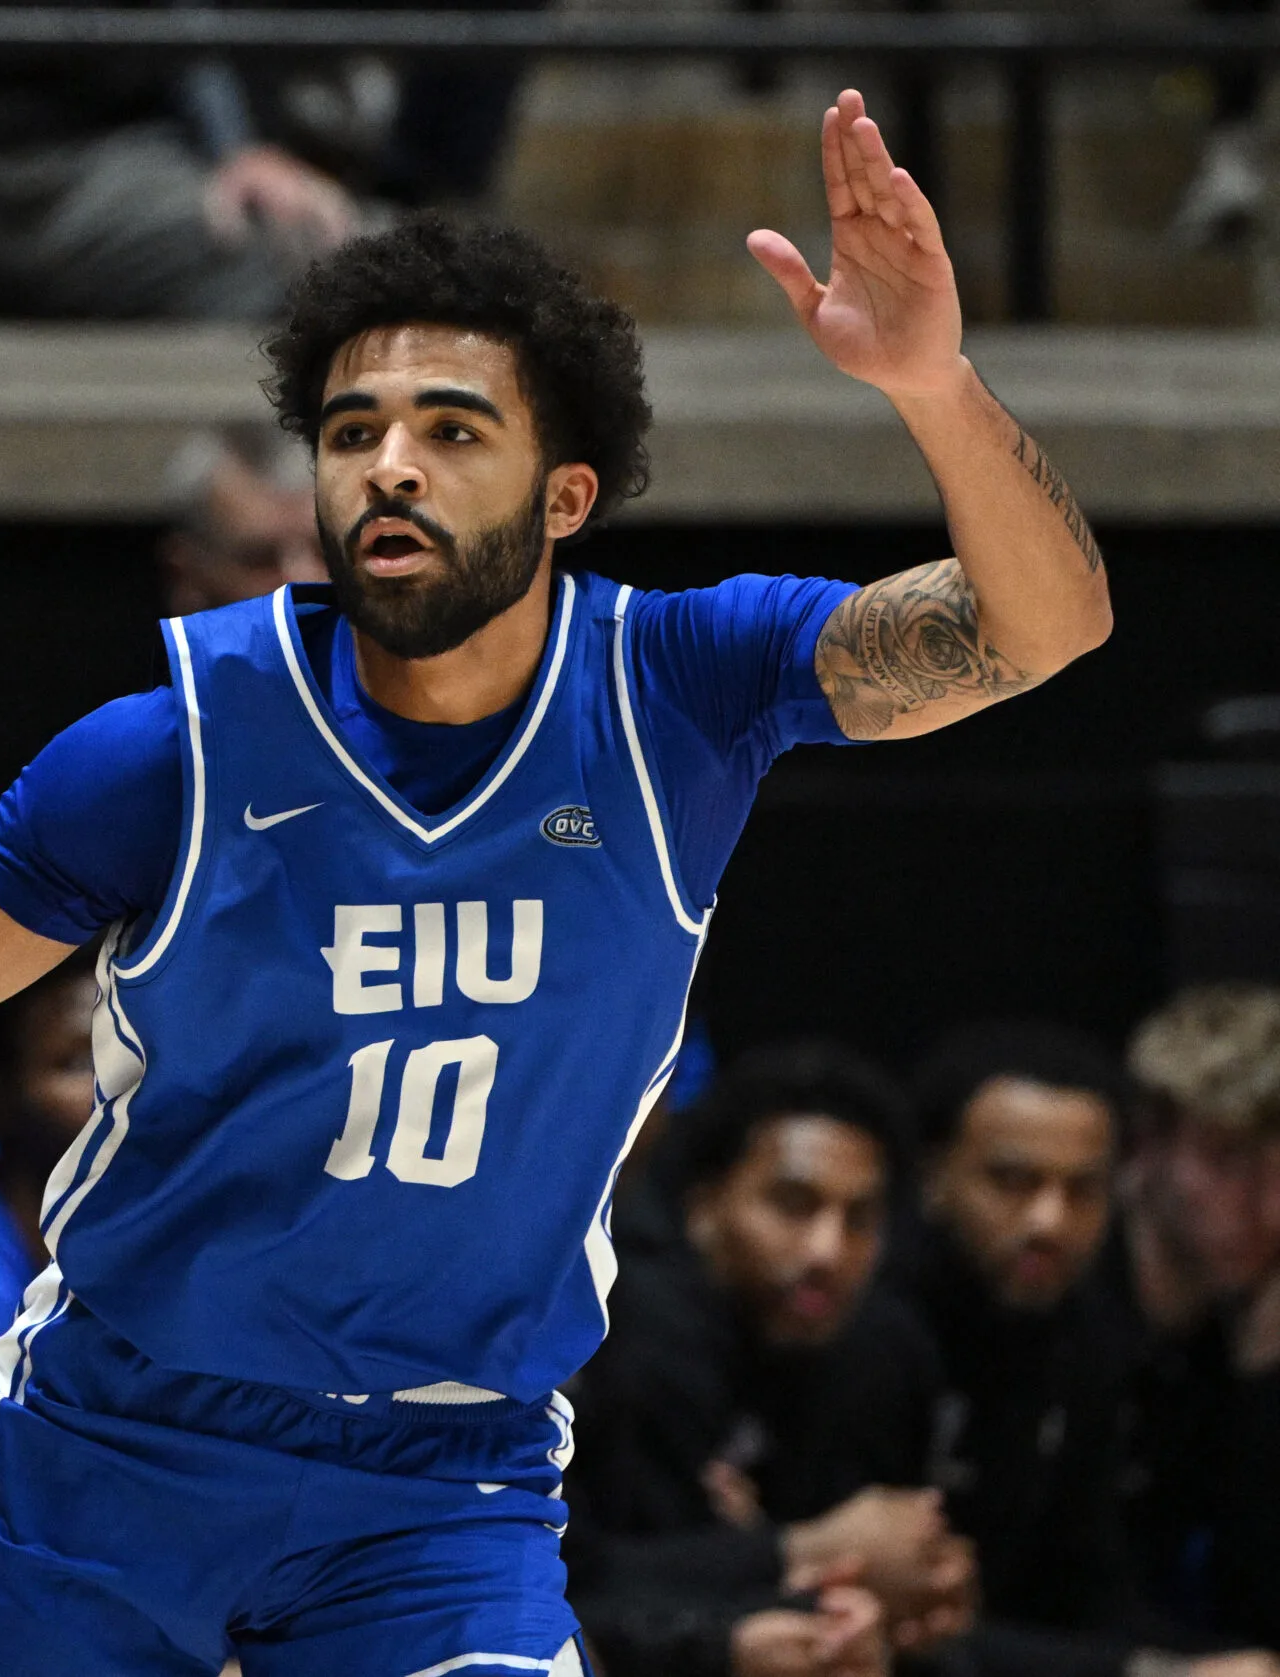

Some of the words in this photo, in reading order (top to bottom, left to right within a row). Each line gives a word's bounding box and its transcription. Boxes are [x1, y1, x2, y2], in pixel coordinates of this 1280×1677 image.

[555, 818, 595, 838] OVC
[320, 900, 544, 1015] EIU
[324, 1034, 499, 1188] 10
